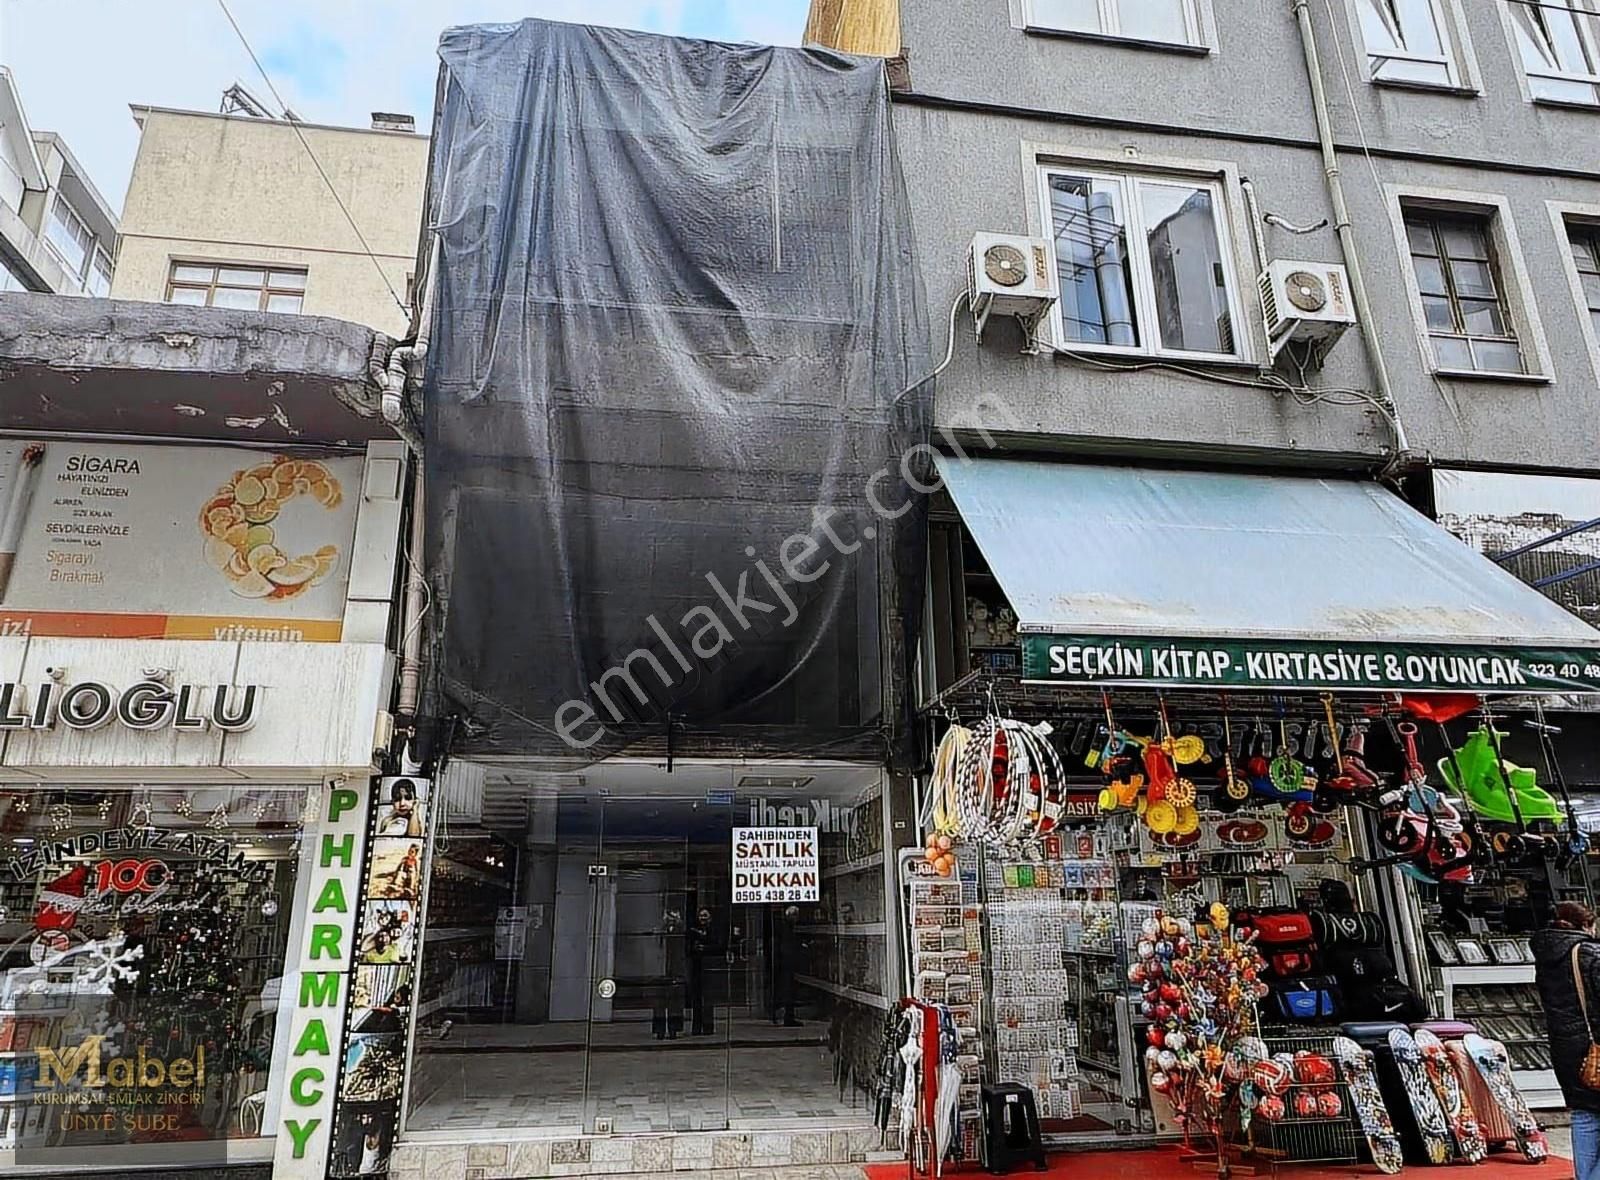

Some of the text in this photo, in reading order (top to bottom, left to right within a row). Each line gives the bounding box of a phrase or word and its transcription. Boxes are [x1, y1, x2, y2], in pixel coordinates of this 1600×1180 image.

[66, 454, 140, 474] SİGARA
[46, 549, 97, 566] Sigarayı
[50, 568, 105, 584] Bırakmak
[1049, 641, 1143, 680] SEÇKİN
[1152, 645, 1230, 679] KİTAP
[1246, 648, 1380, 682] KIRTASİYE
[1528, 663, 1556, 678] 323
[1560, 664, 1580, 678] 40
[739, 830, 812, 841] SAHİBİNDEN
[736, 842, 814, 858] SATILIK
[736, 868, 816, 888] DÜKKAN
[736, 891, 762, 901] 0505
[804, 890, 816, 899] 41
[284, 789, 359, 1159] PHARMACY
